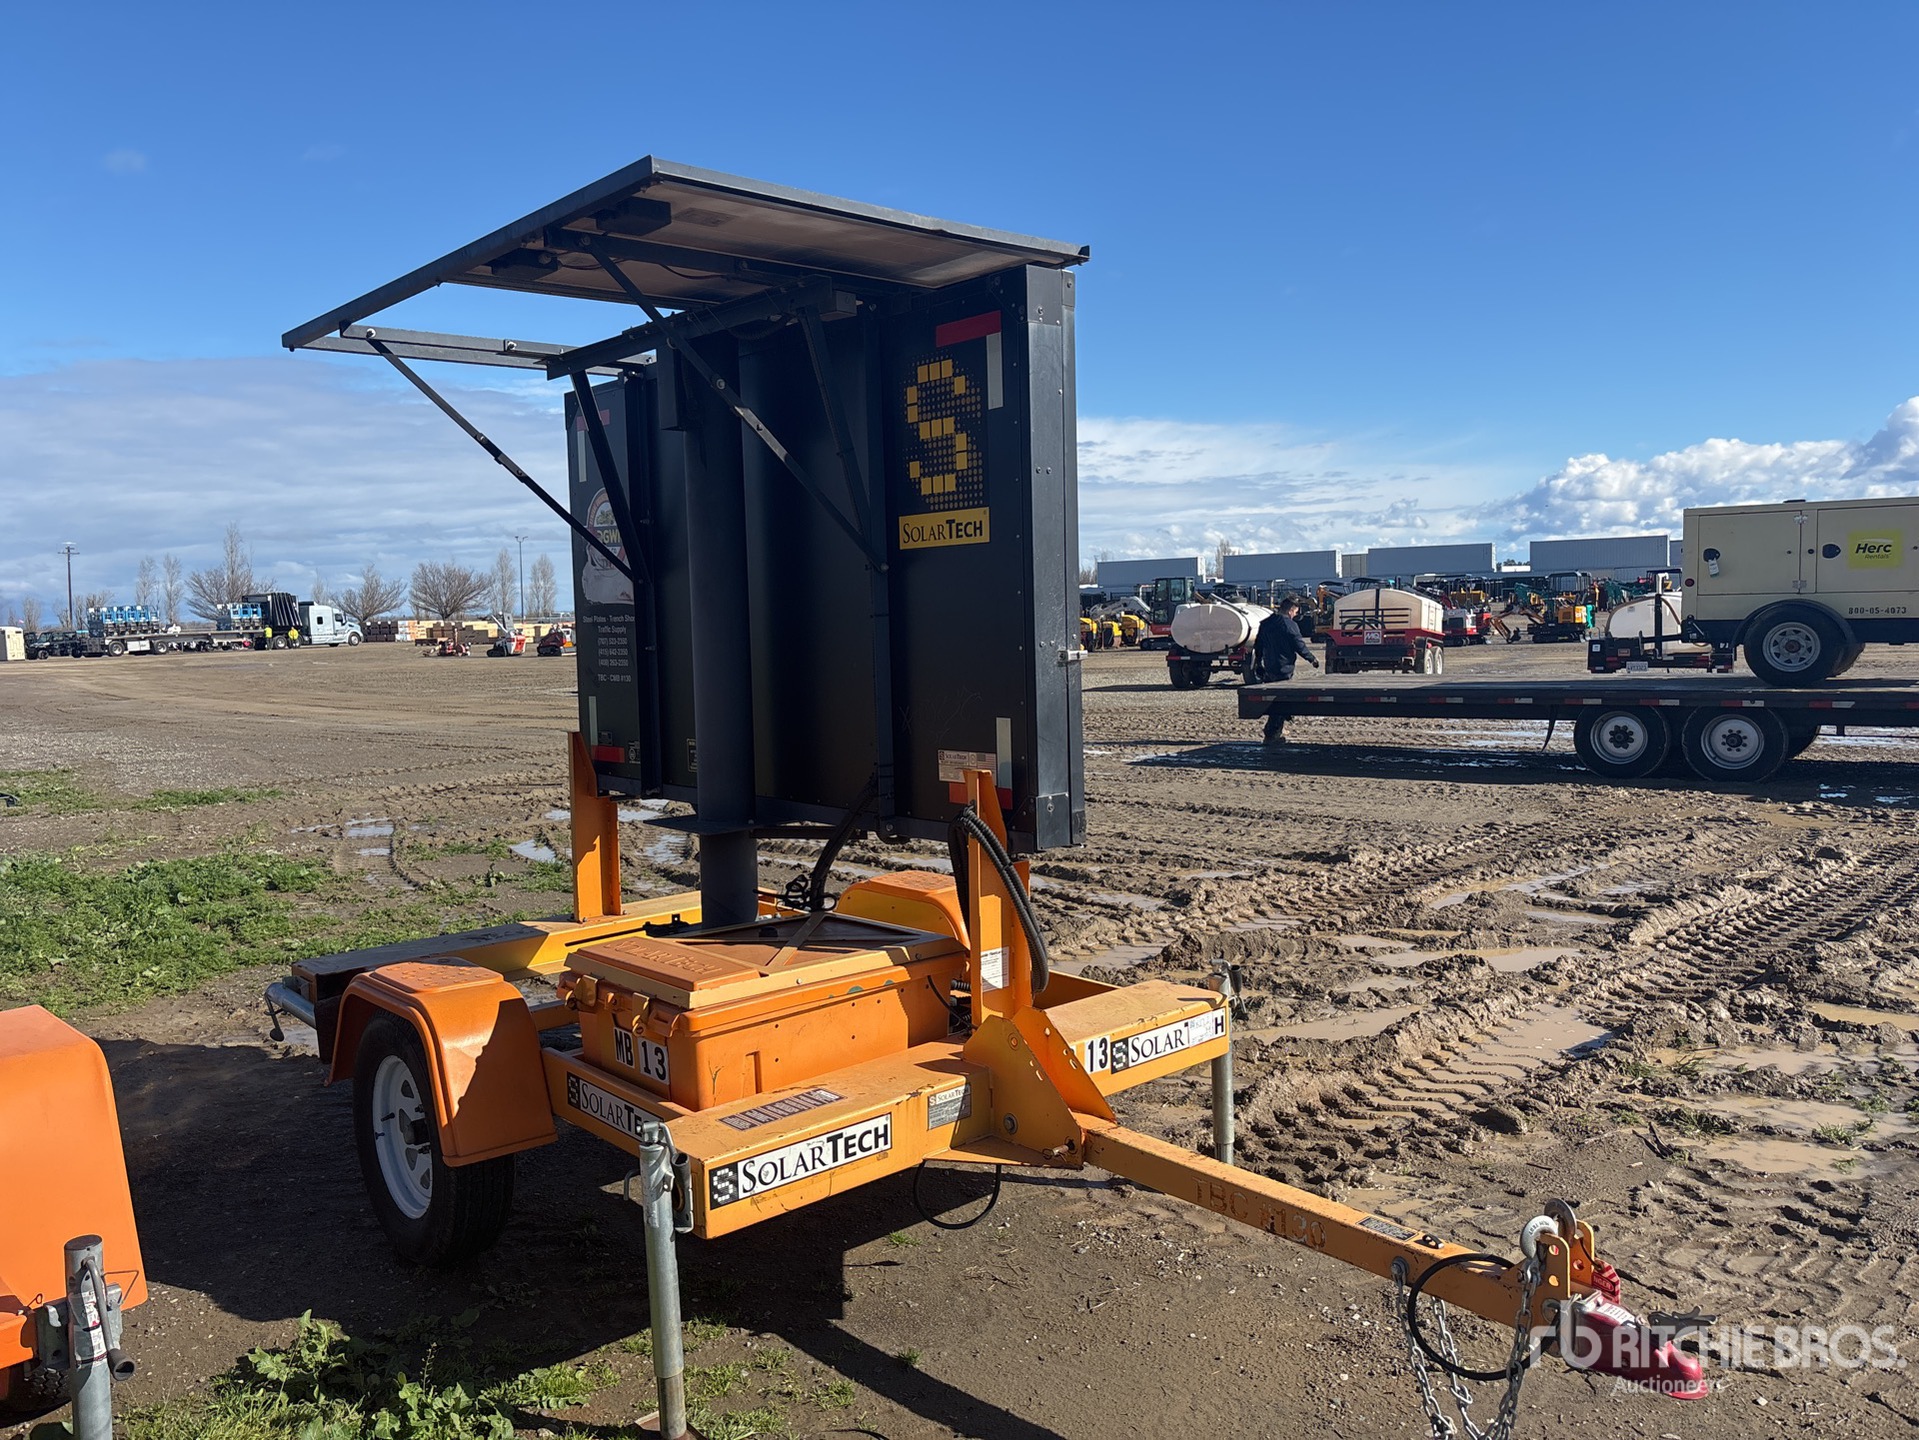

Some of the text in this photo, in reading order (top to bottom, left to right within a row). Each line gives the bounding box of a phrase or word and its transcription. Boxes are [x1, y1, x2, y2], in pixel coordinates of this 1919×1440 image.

[903, 519, 983, 544] SOLARTECH
[1855, 543, 1892, 554] Herc
[1848, 606, 1907, 615] 800-05-4073
[615, 1028, 667, 1081] MB 13
[1088, 1037, 1108, 1073] 13
[741, 1123, 890, 1194] SOLARTECH
